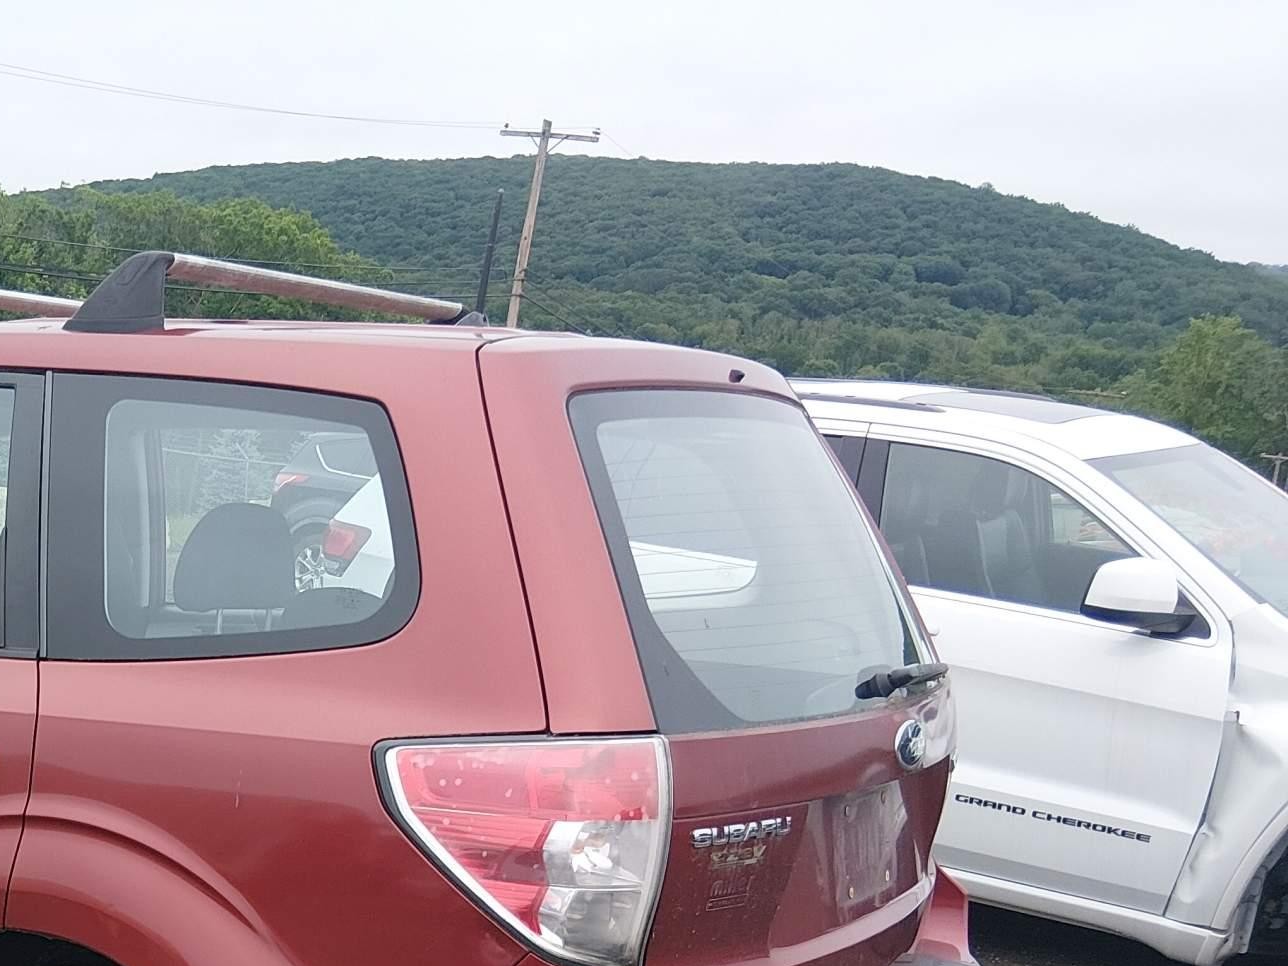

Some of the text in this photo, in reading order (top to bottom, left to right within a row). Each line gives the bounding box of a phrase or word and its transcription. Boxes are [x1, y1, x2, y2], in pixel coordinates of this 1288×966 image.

[691, 816, 792, 848] SUBARU
[954, 793, 1153, 844] GRAND CHEROKEE
